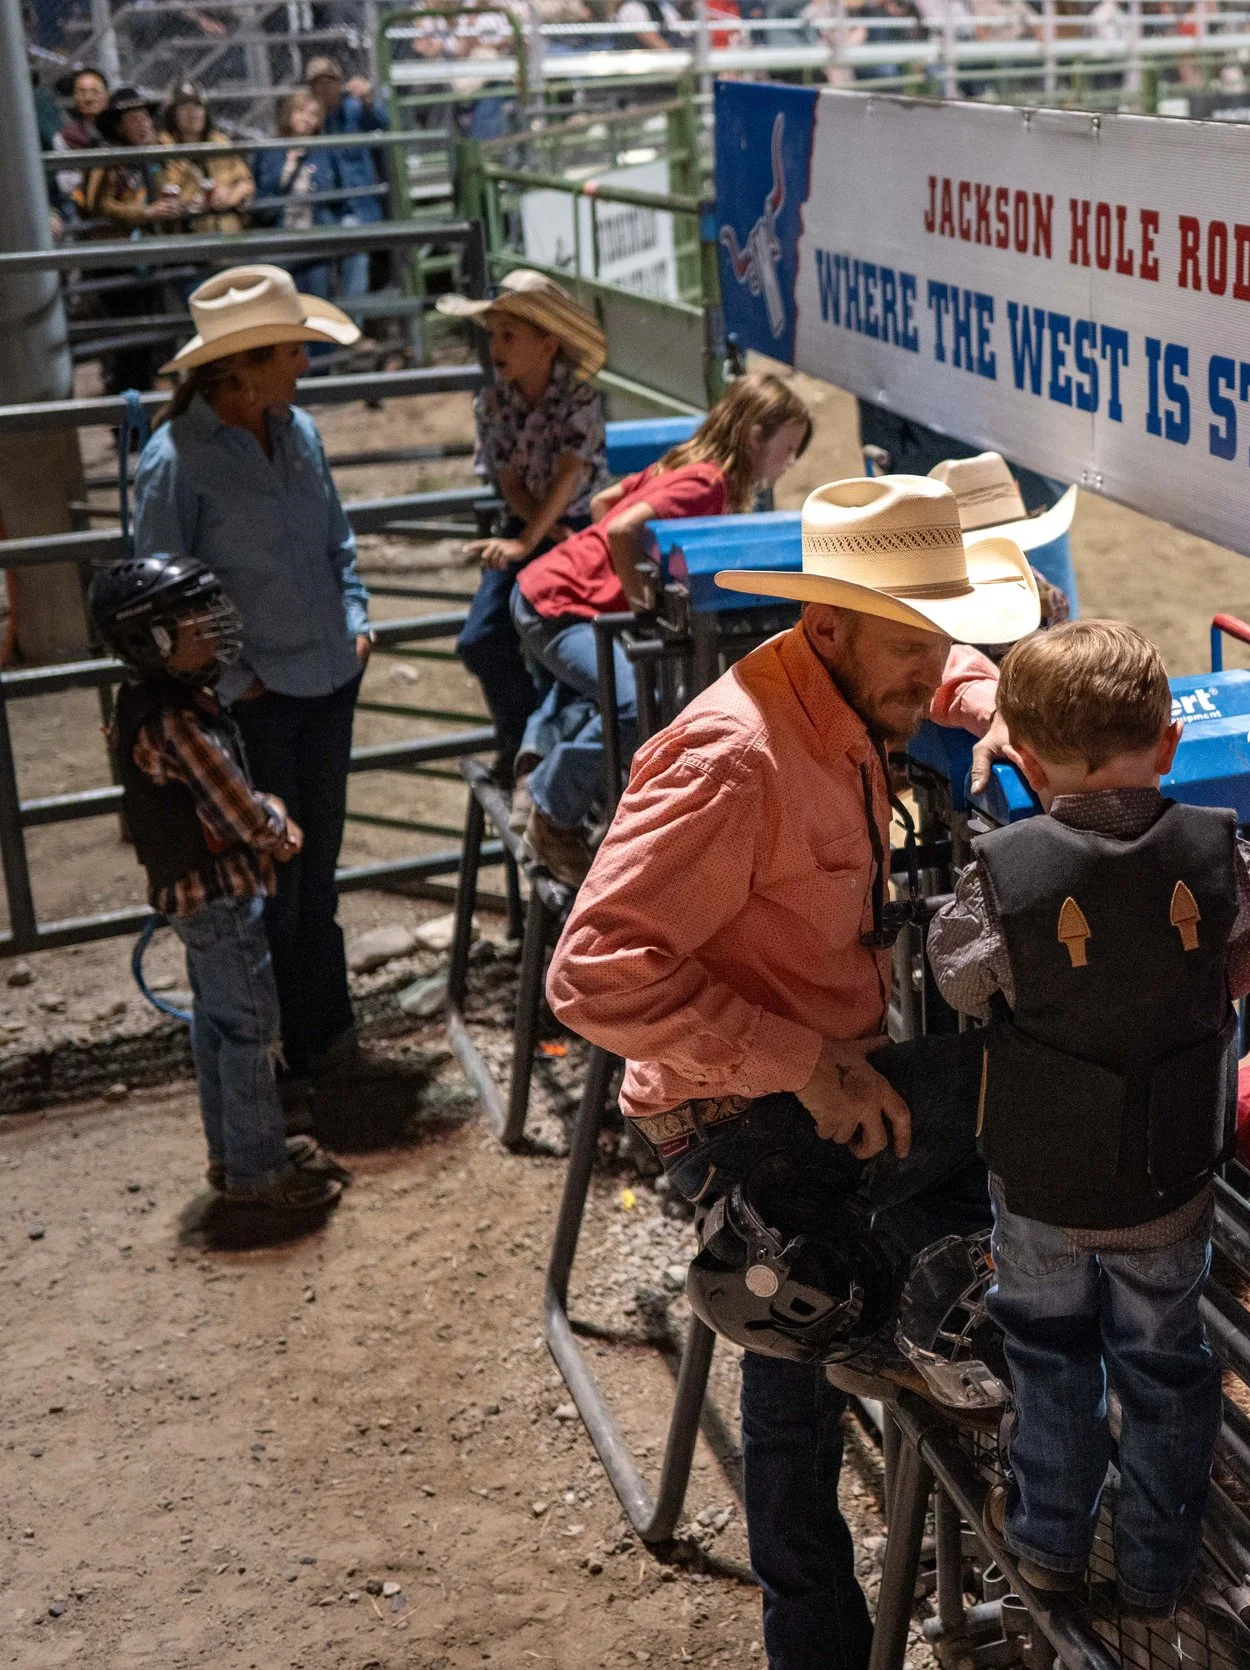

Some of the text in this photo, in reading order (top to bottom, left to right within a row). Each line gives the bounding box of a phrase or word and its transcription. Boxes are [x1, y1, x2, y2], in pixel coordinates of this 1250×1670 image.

[924, 175, 1053, 259] JACKSON
[1069, 199, 1159, 281] HOLE
[815, 248, 919, 354] WHERE
[927, 279, 997, 381] THE
[1007, 301, 1128, 423] WEST
[1144, 336, 1189, 446] IS
